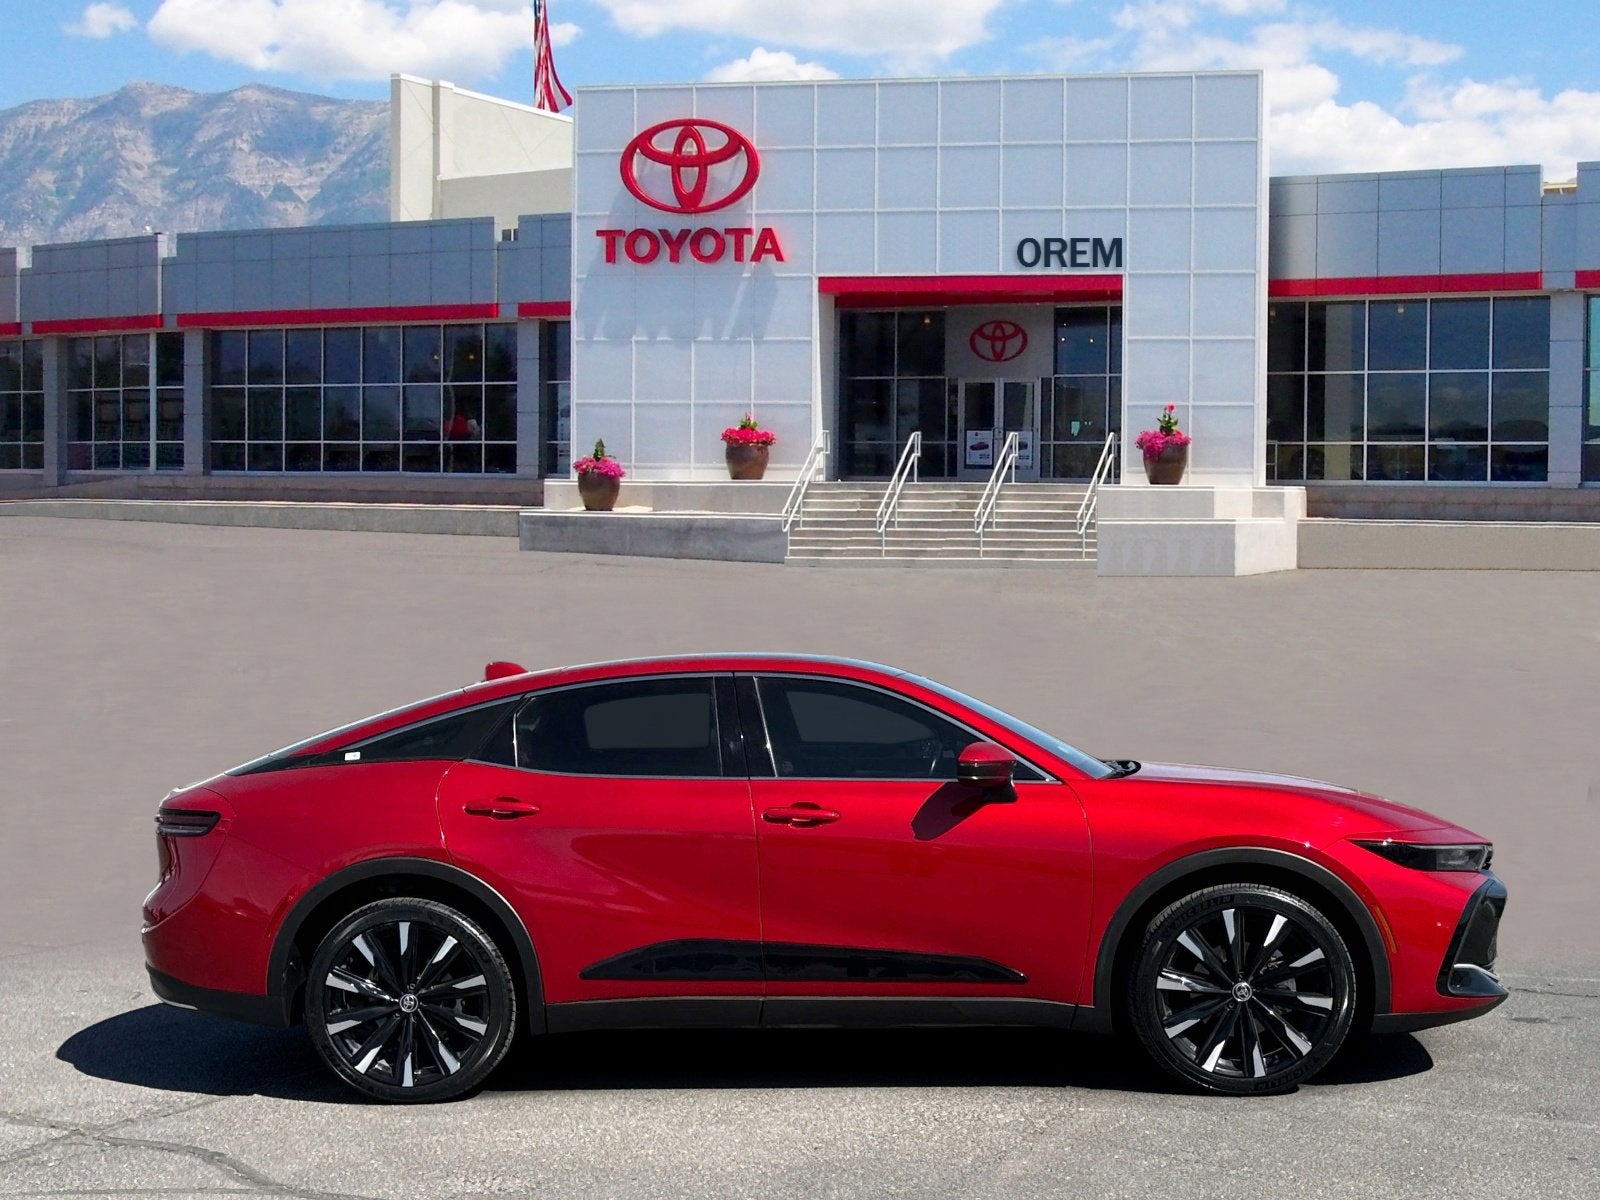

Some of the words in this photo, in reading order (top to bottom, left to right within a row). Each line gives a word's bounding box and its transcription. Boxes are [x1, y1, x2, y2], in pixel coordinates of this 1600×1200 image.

[596, 227, 784, 264] TOYOTA
[1017, 237, 1122, 267] OREM
[1170, 894, 1235, 930] MICHELIN
